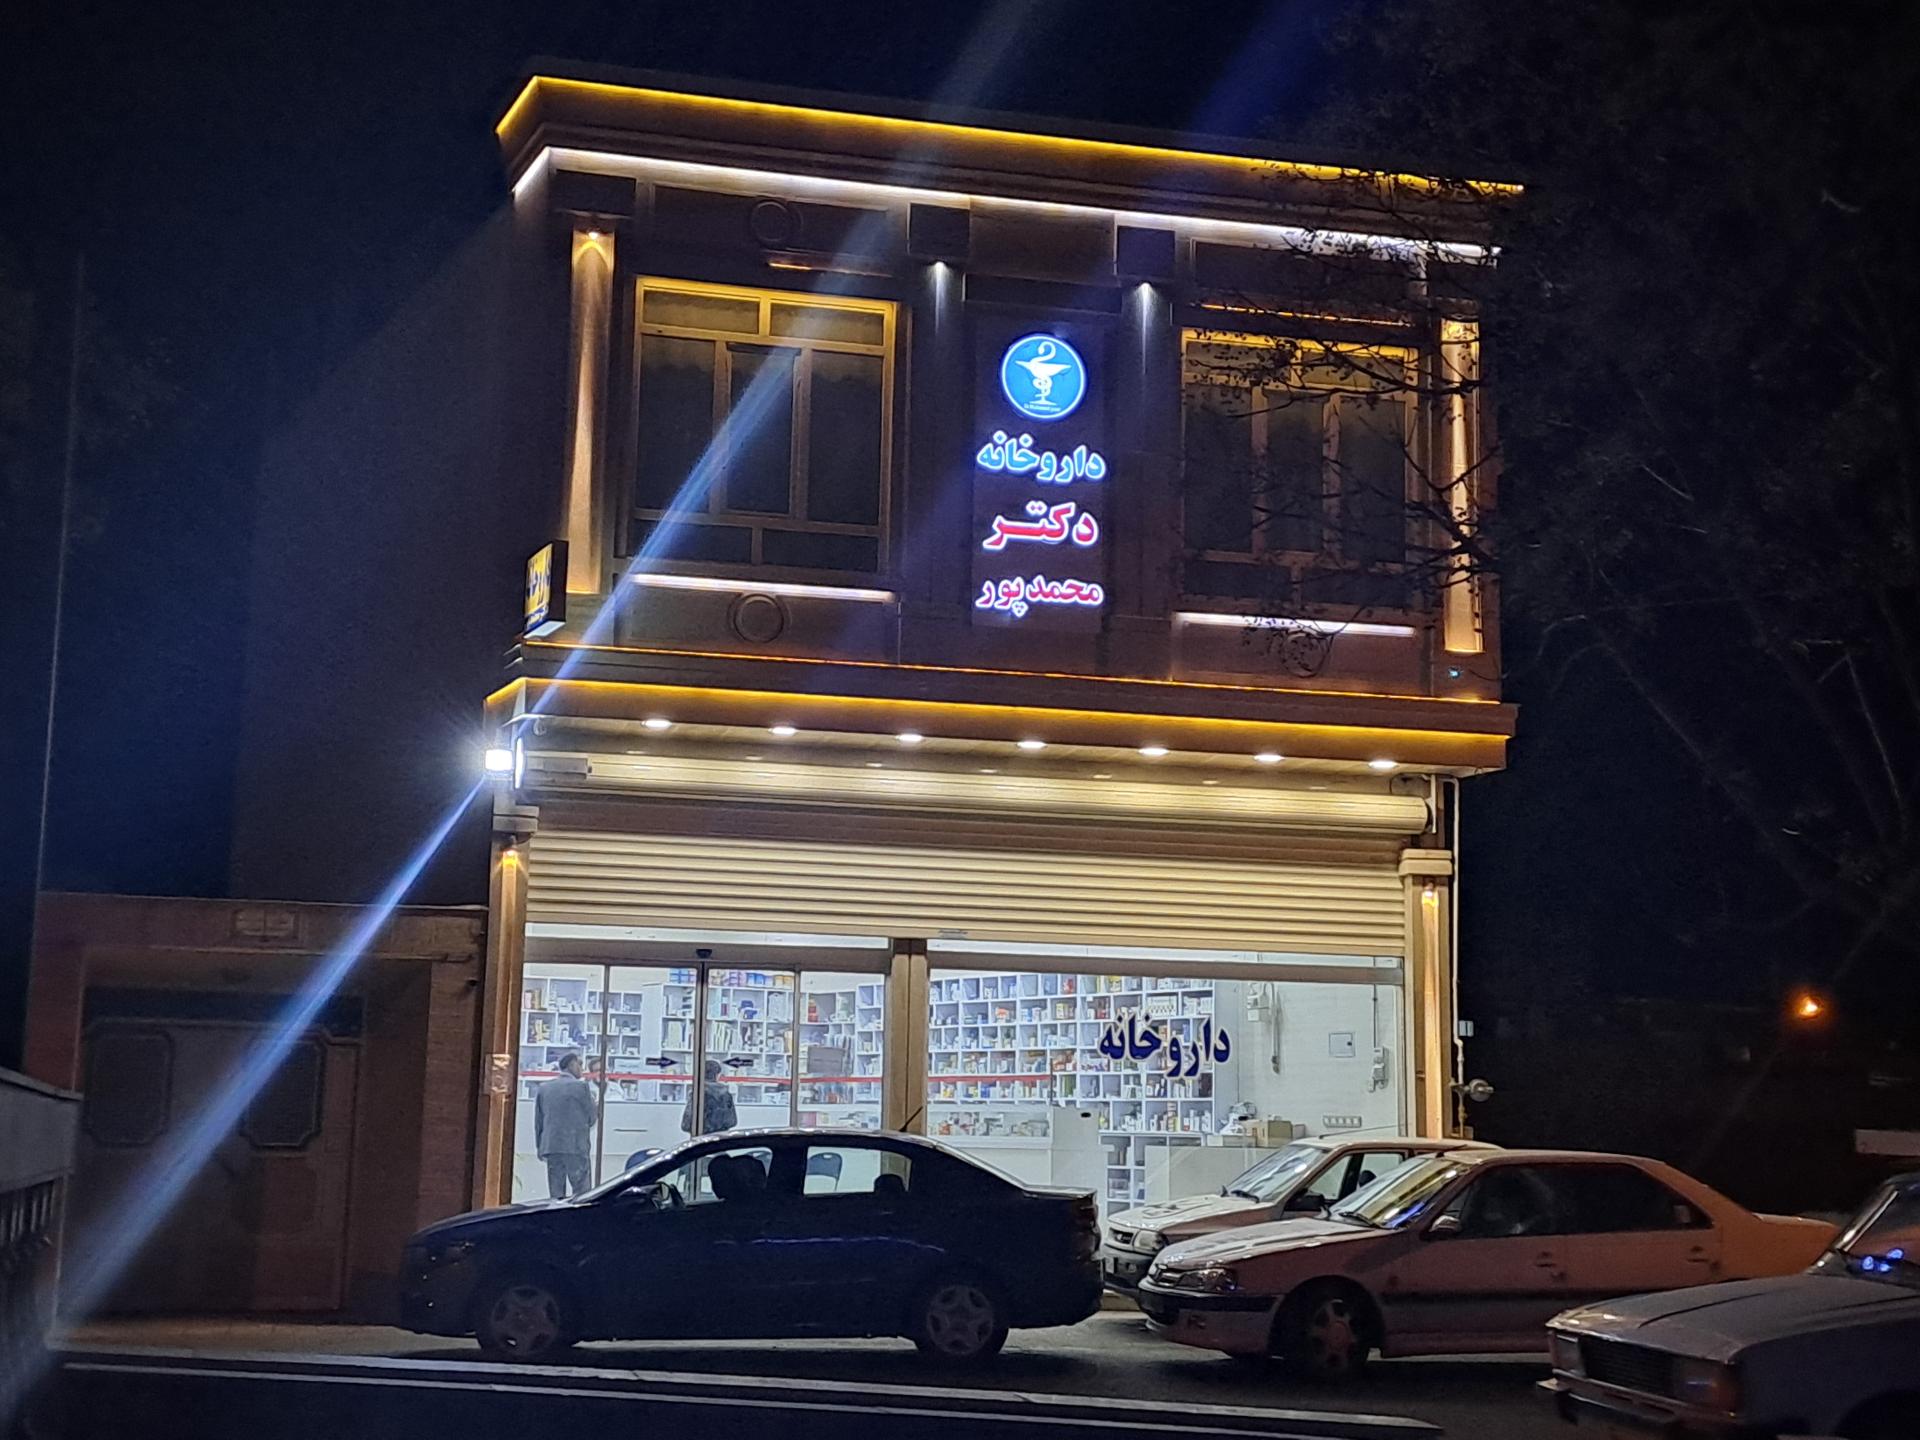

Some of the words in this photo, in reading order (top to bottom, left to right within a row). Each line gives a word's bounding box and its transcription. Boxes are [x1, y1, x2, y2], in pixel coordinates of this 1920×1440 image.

[976, 431, 1106, 482] داروخانه
[982, 501, 1098, 550] دکتر
[1099, 1013, 1232, 1078] داروخانه
